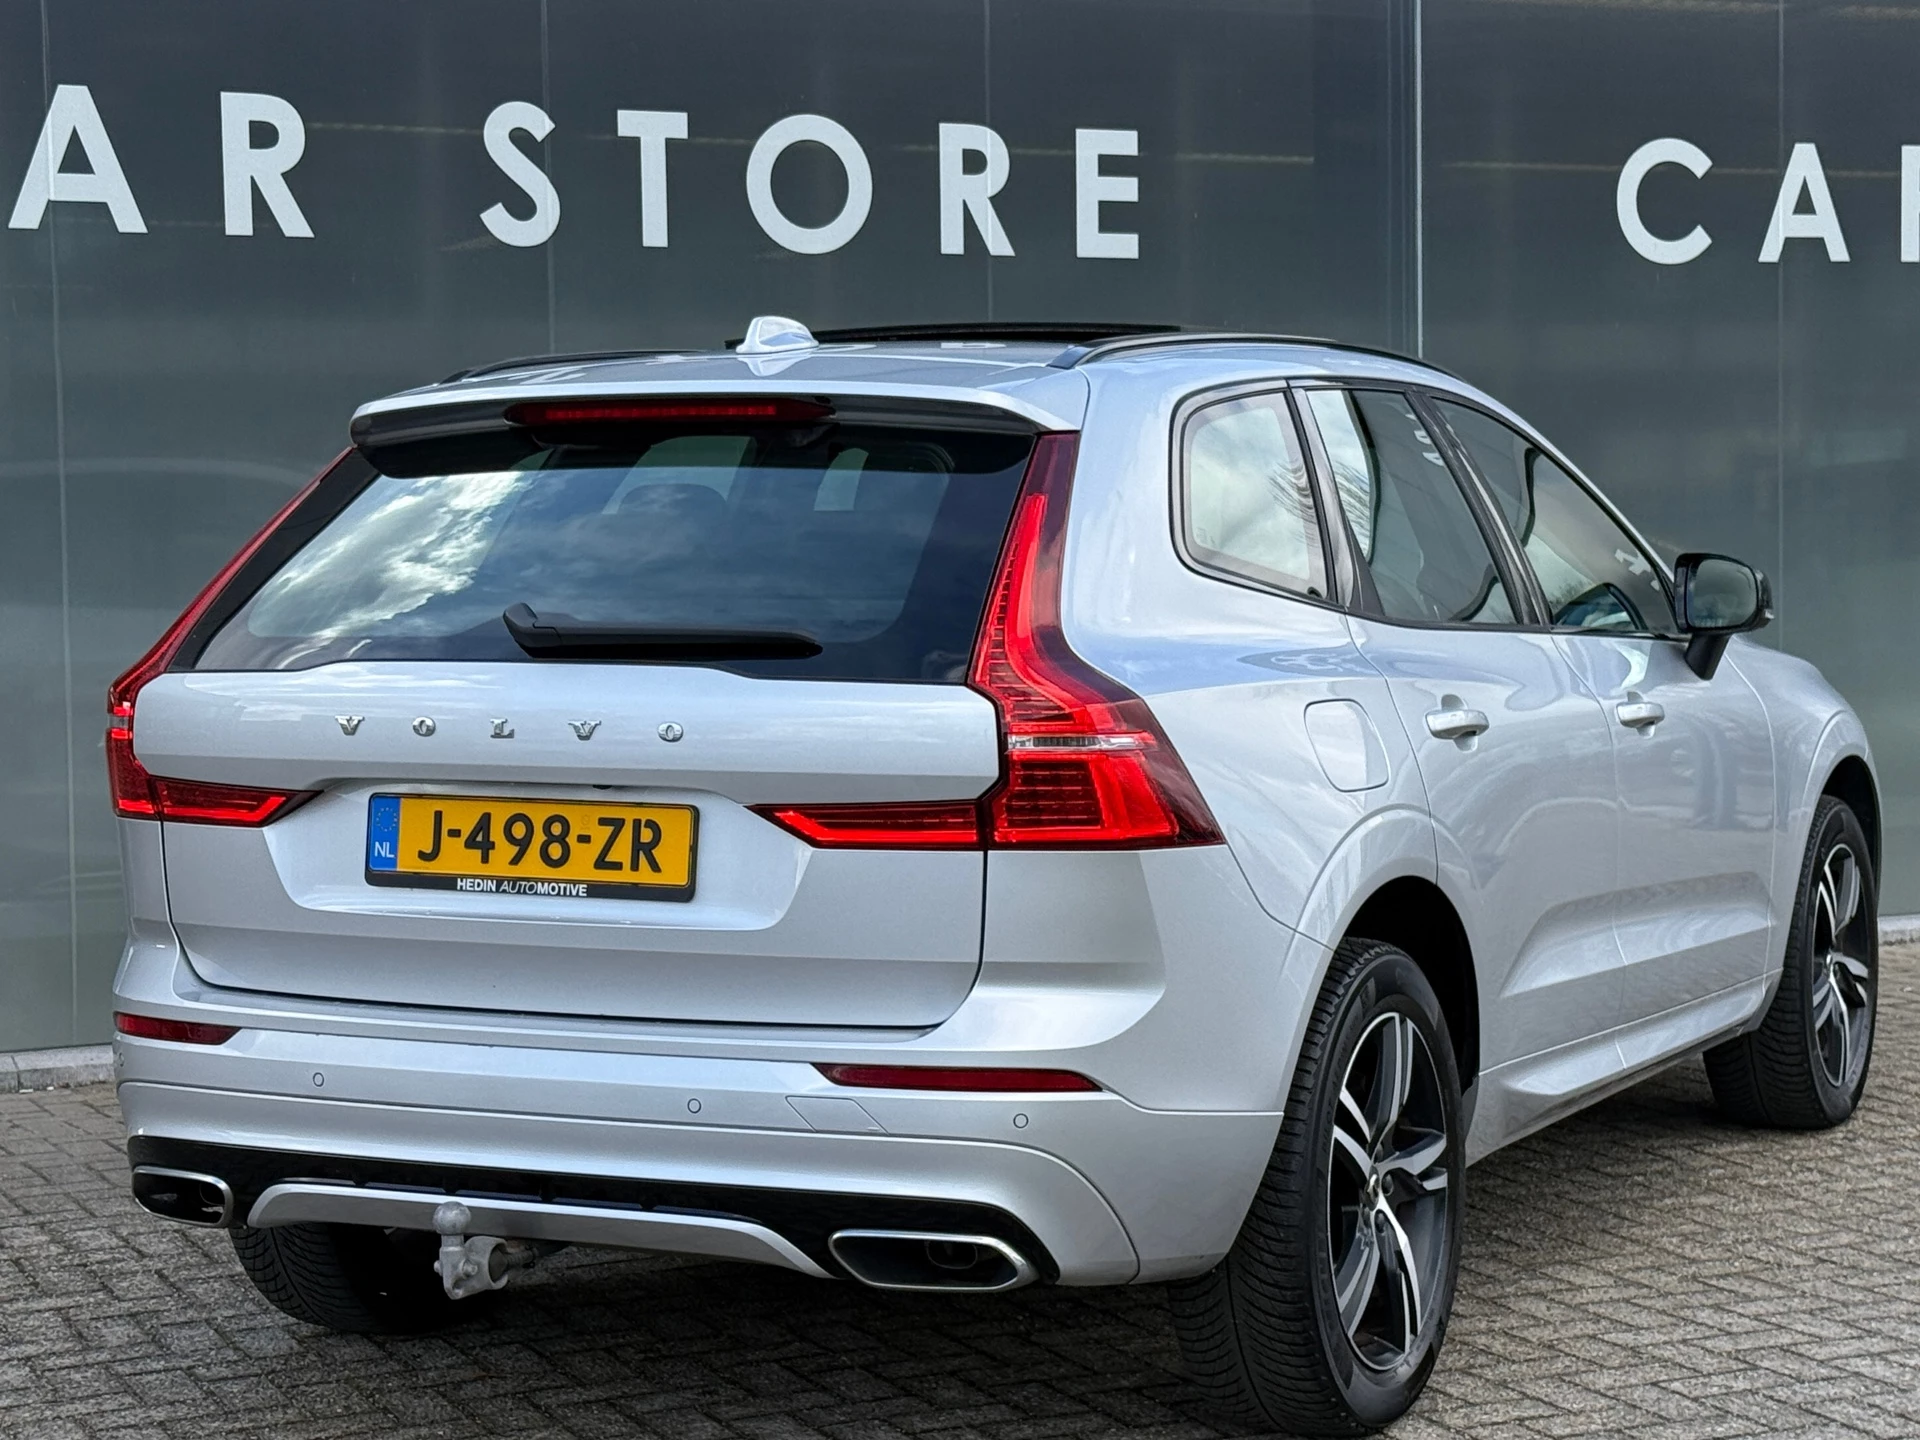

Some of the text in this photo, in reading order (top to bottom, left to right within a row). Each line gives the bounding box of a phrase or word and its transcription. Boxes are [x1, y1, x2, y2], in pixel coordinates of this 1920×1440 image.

[8, 84, 1140, 259] AR STORE
[336, 715, 684, 743] VOLVO
[374, 841, 395, 859] NL
[417, 809, 662, 873] J-498-ZR
[456, 878, 588, 897] HEDIN AUTOMOTIVE
